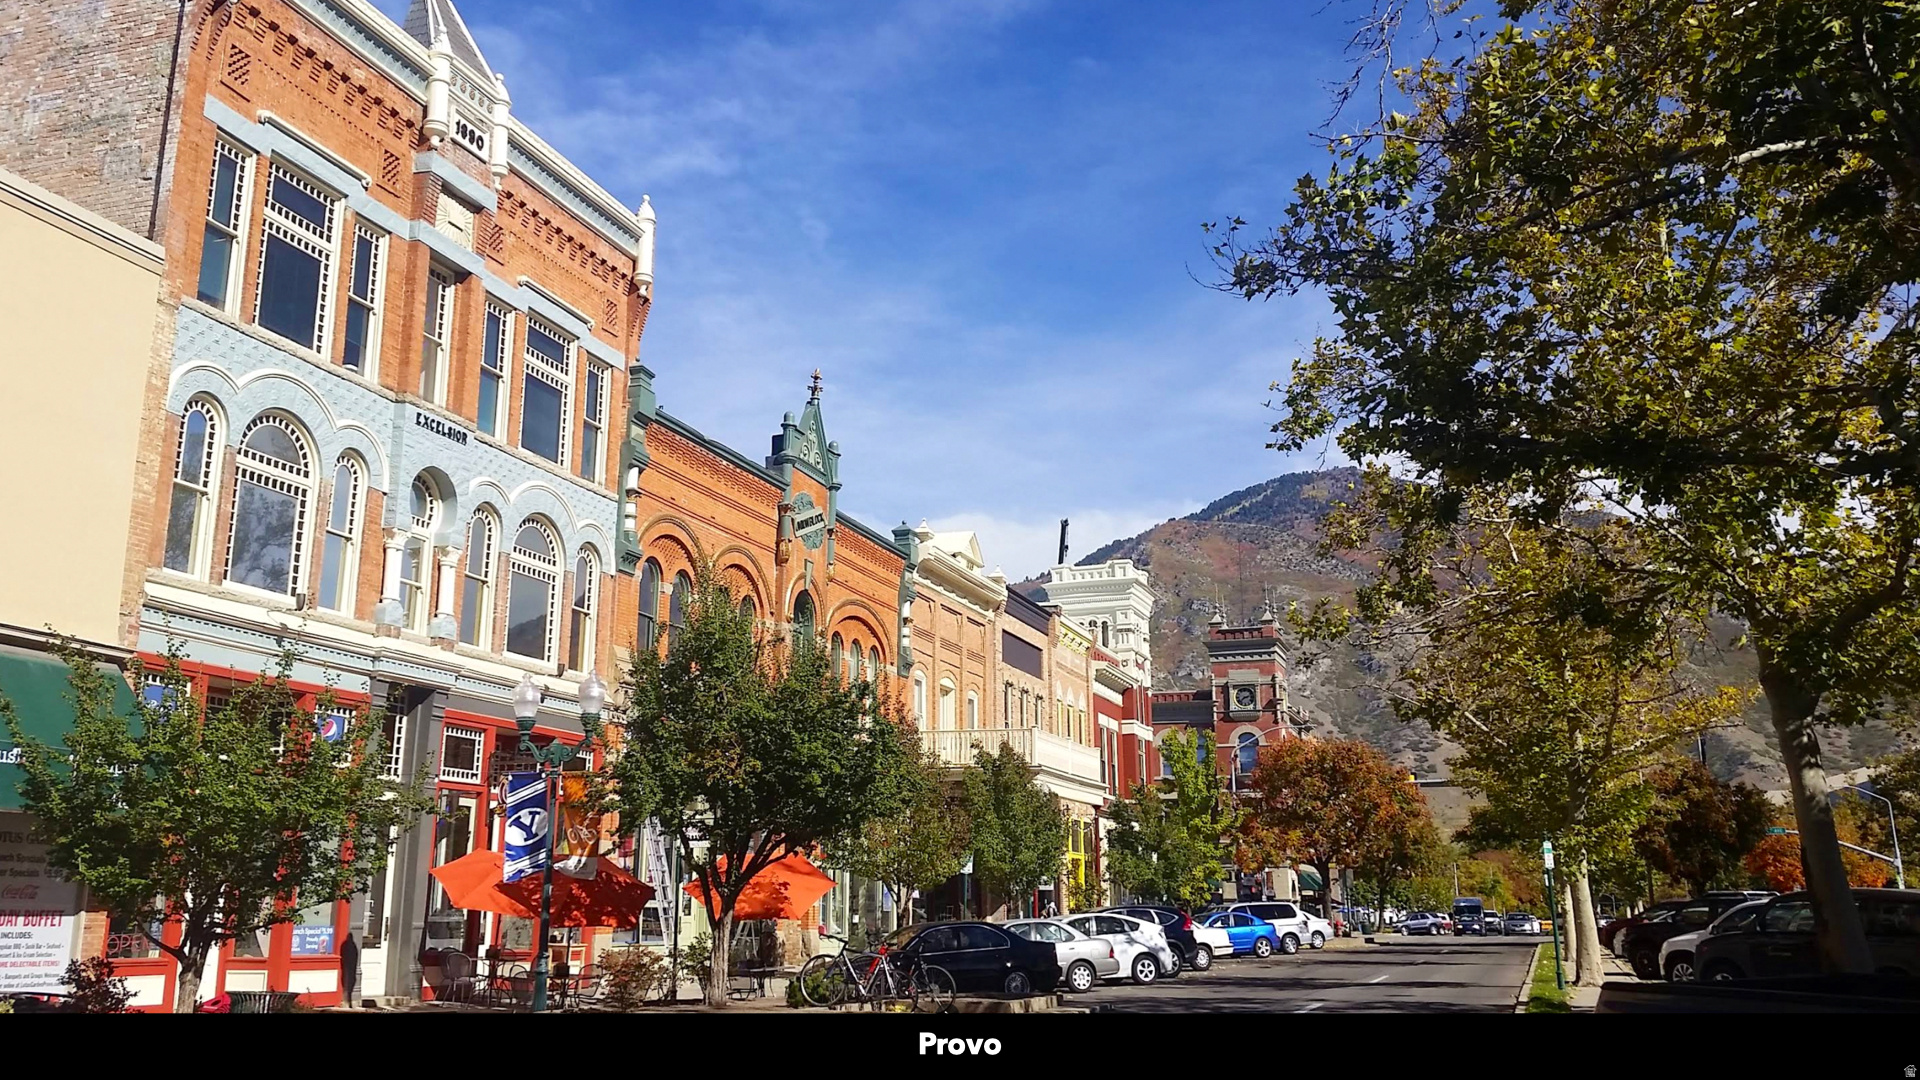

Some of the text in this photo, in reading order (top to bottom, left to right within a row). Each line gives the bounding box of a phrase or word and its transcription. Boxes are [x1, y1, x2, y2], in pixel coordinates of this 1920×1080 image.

[415, 412, 468, 446] EXCELSIOR
[810, 512, 825, 526] BLOCK
[508, 811, 541, 842] Y
[23, 909, 64, 927] BUFFET
[1, 931, 34, 940] INCLUDES:
[9, 960, 41, 968] DELECTABLE
